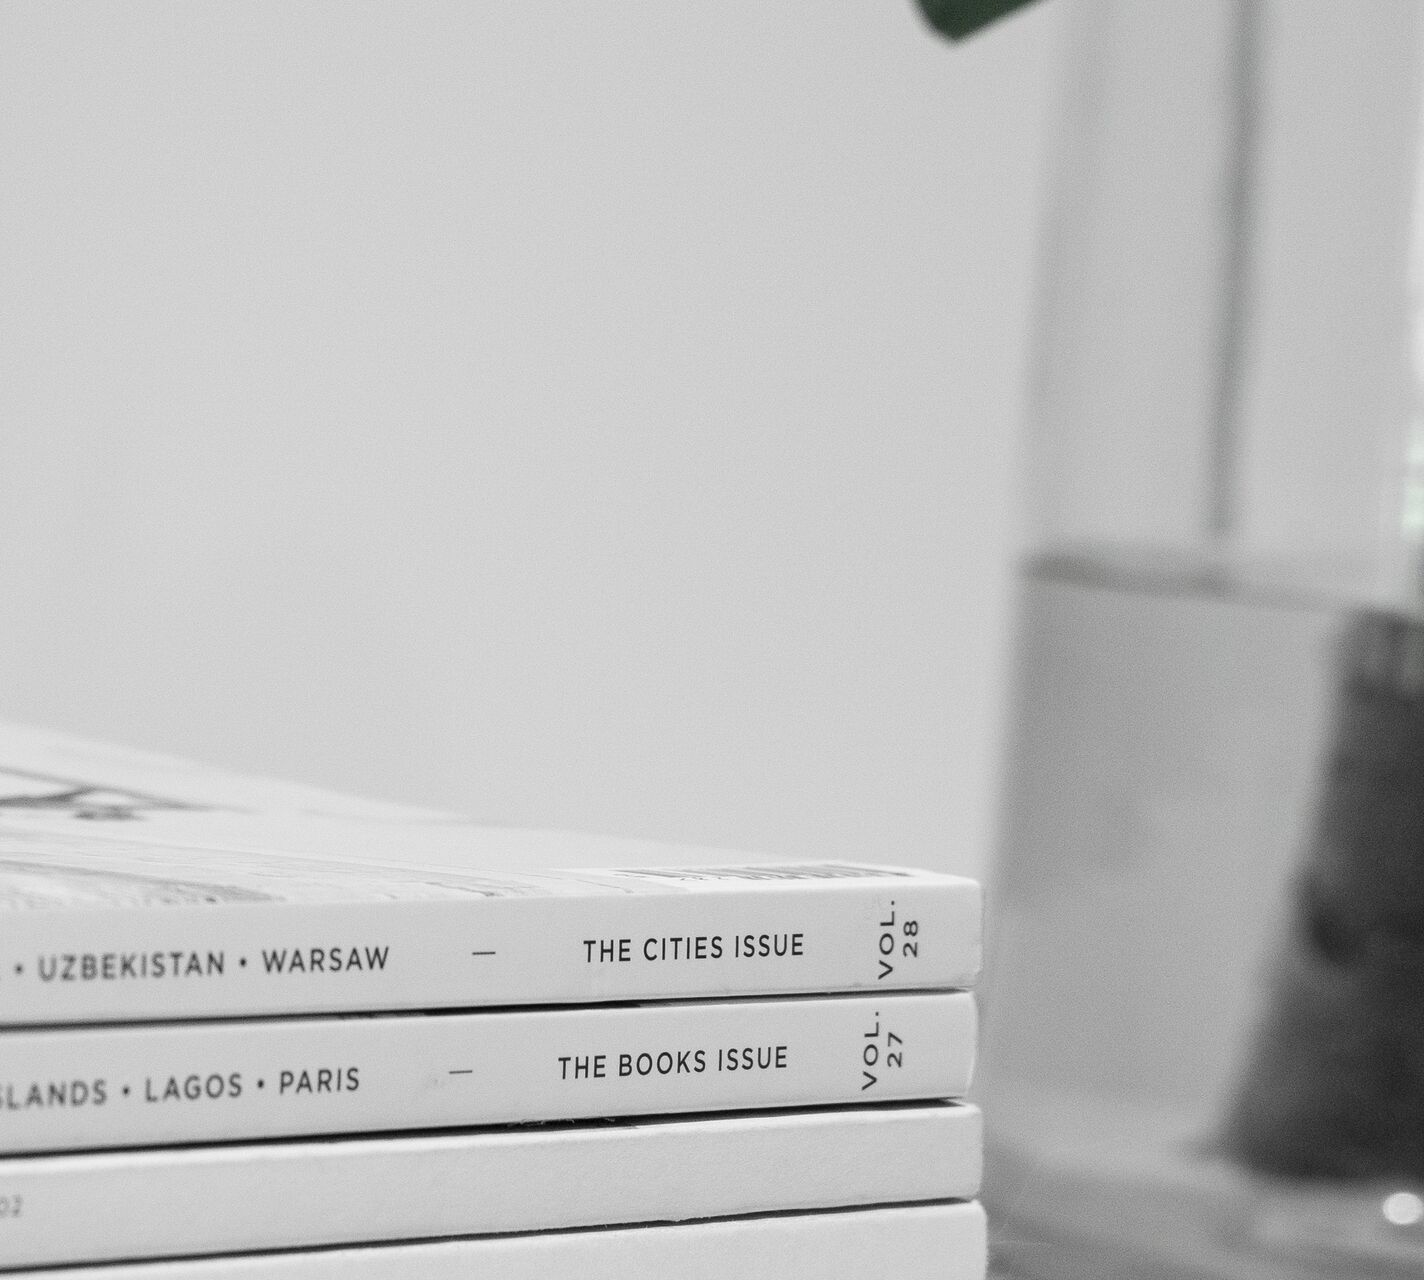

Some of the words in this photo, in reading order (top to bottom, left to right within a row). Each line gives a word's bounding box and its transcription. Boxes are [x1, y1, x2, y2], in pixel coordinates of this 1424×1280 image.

[37, 950, 226, 983] UZBEKISTAN
[261, 946, 390, 974] WARSAW
[582, 937, 632, 964] THE
[642, 934, 724, 963] CITIES
[733, 931, 805, 960] ISSUE
[877, 900, 898, 980] VOL.
[901, 919, 920, 958] 28
[144, 1071, 244, 1104] LAGOS
[278, 1065, 361, 1095] PARIS
[557, 1053, 607, 1080] THE
[617, 1047, 707, 1079] BOOKS
[717, 1044, 788, 1073] ISSUE
[860, 1011, 881, 1092] VOL.
[885, 1031, 904, 1069] 27
